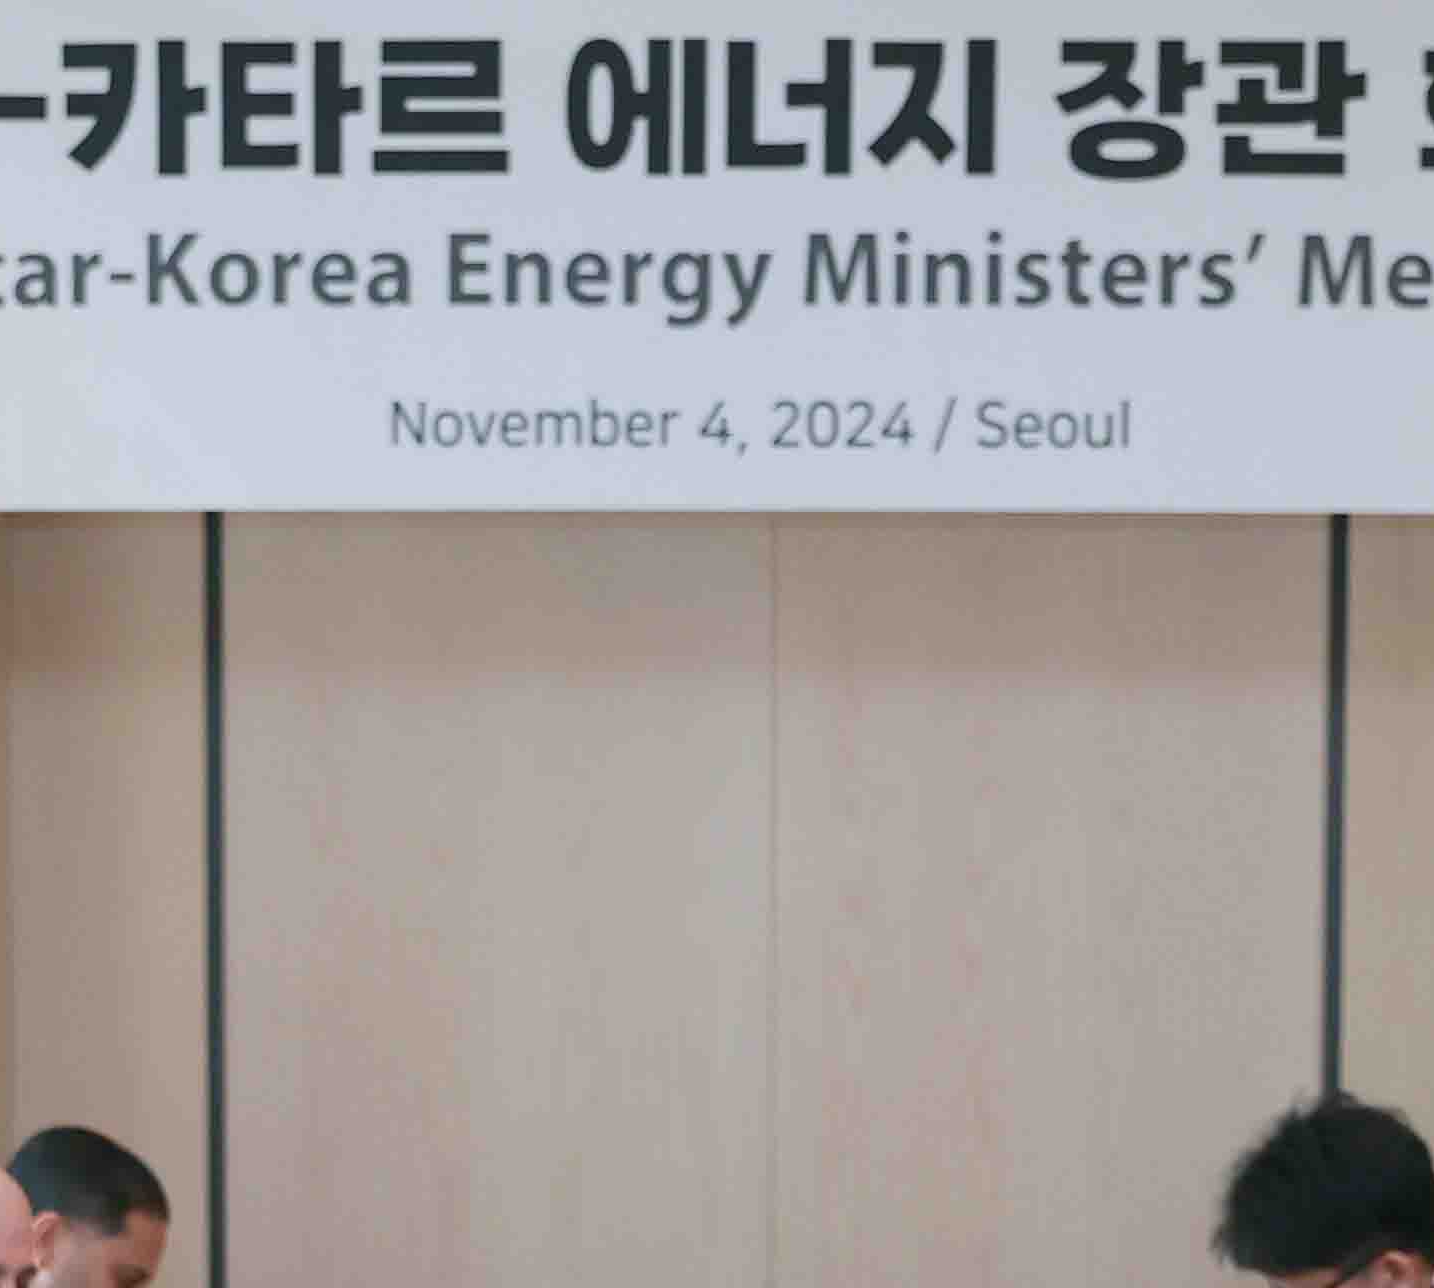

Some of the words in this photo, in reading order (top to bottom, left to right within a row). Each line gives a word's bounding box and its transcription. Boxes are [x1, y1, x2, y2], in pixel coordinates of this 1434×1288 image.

[566, 37, 998, 177] 에너지
[1055, 39, 1369, 181] 장관
[448, 232, 773, 328] Energy
[392, 399, 679, 448] November
[699, 402, 747, 453] 4,
[773, 400, 914, 449] 2024
[935, 399, 956, 452] /
[977, 399, 1130, 449] Seoul
